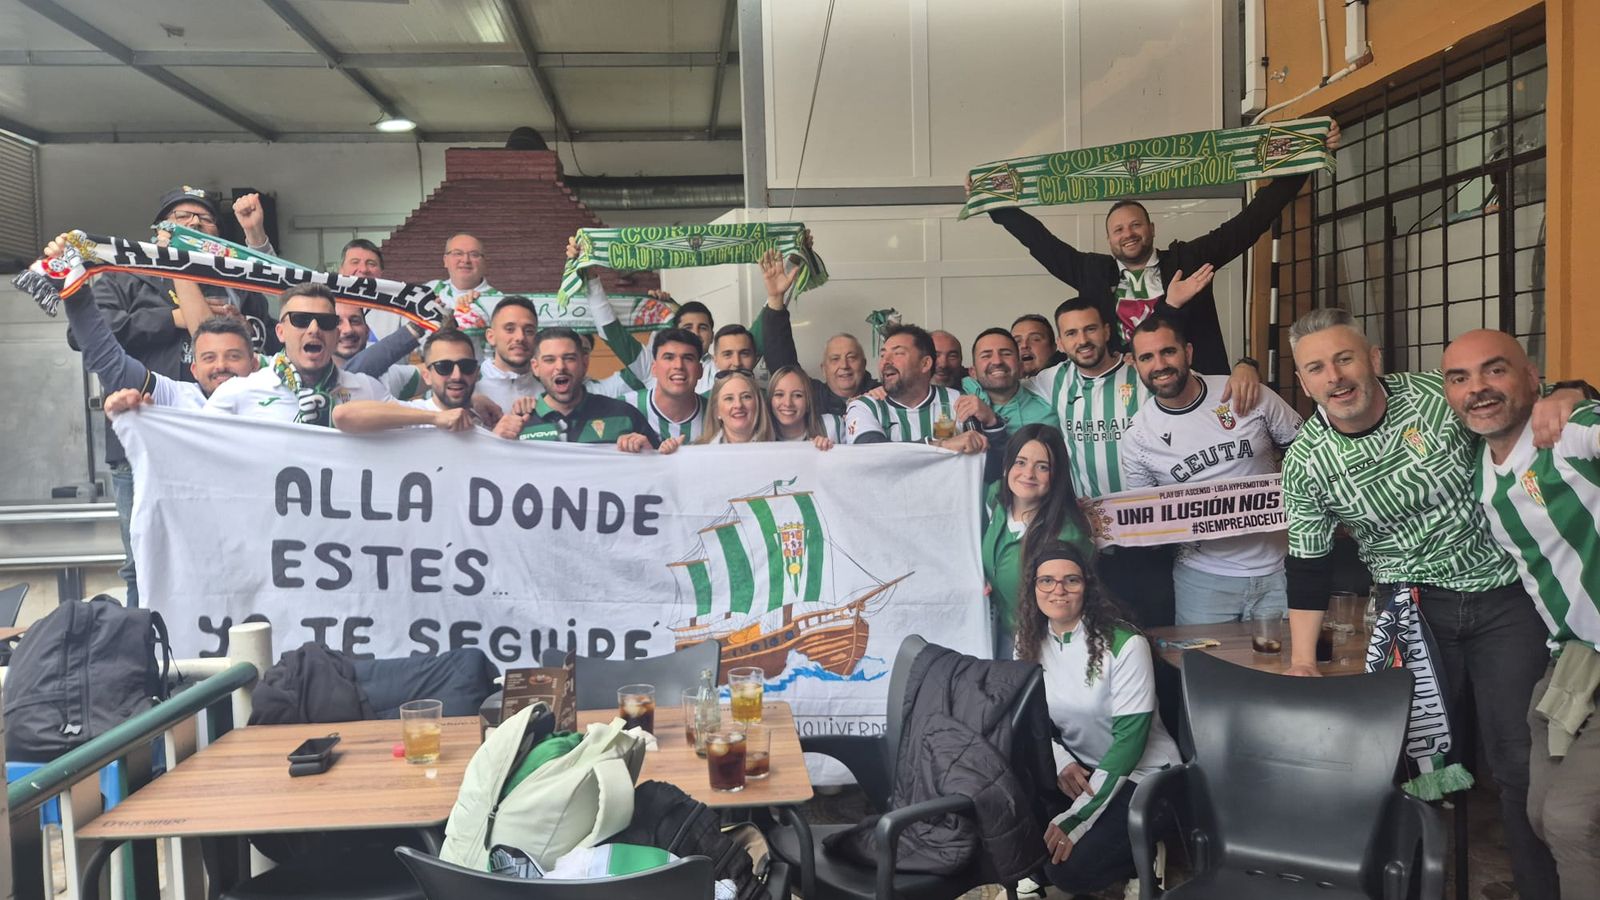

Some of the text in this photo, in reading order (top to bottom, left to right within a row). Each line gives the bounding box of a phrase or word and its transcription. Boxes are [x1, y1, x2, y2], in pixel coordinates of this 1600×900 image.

[1037, 174, 1098, 204] CLUB
[1103, 176, 1135, 198] DE
[608, 241, 665, 270] CLUB
[669, 250, 698, 268] DE
[114, 238, 192, 270] AD
[391, 281, 445, 321] FC
[519, 430, 558, 440] GIVOVA
[1170, 439, 1254, 483] CEUTA
[275, 466, 664, 536] ALLÁ DONDE
[1185, 486, 1211, 497] ASCENSO
[1214, 484, 1229, 493] LIGA
[1229, 480, 1270, 492] HYPERMOTION
[1116, 491, 1281, 526] UNA ILUSIÓN NOS
[198, 613, 271, 658] Y
[301, 617, 375, 660] TE
